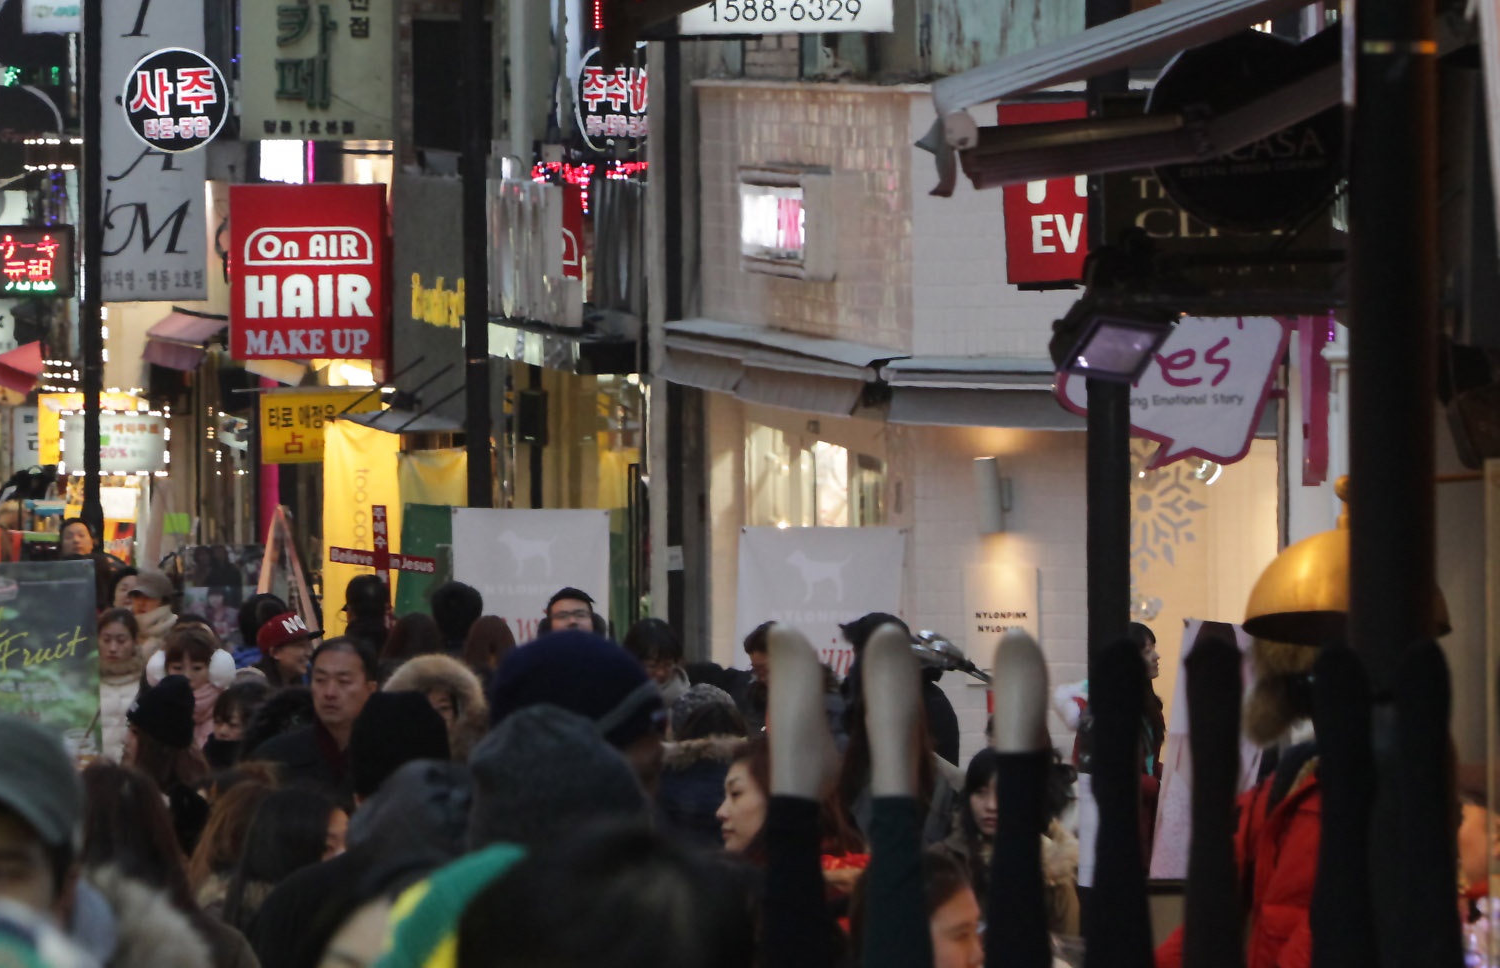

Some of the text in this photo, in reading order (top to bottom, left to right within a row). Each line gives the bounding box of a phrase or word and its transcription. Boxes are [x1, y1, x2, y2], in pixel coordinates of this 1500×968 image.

[129, 67, 218, 116] 사주
[256, 233, 360, 259] On AIR
[244, 273, 374, 319] HAIR
[245, 328, 370, 356] MAKE UP
[1152, 393, 1208, 406] Emotional
[1211, 392, 1244, 408] Story
[330, 548, 435, 574] Believe in Jesus
[975, 611, 1028, 620] NYLONPINK
